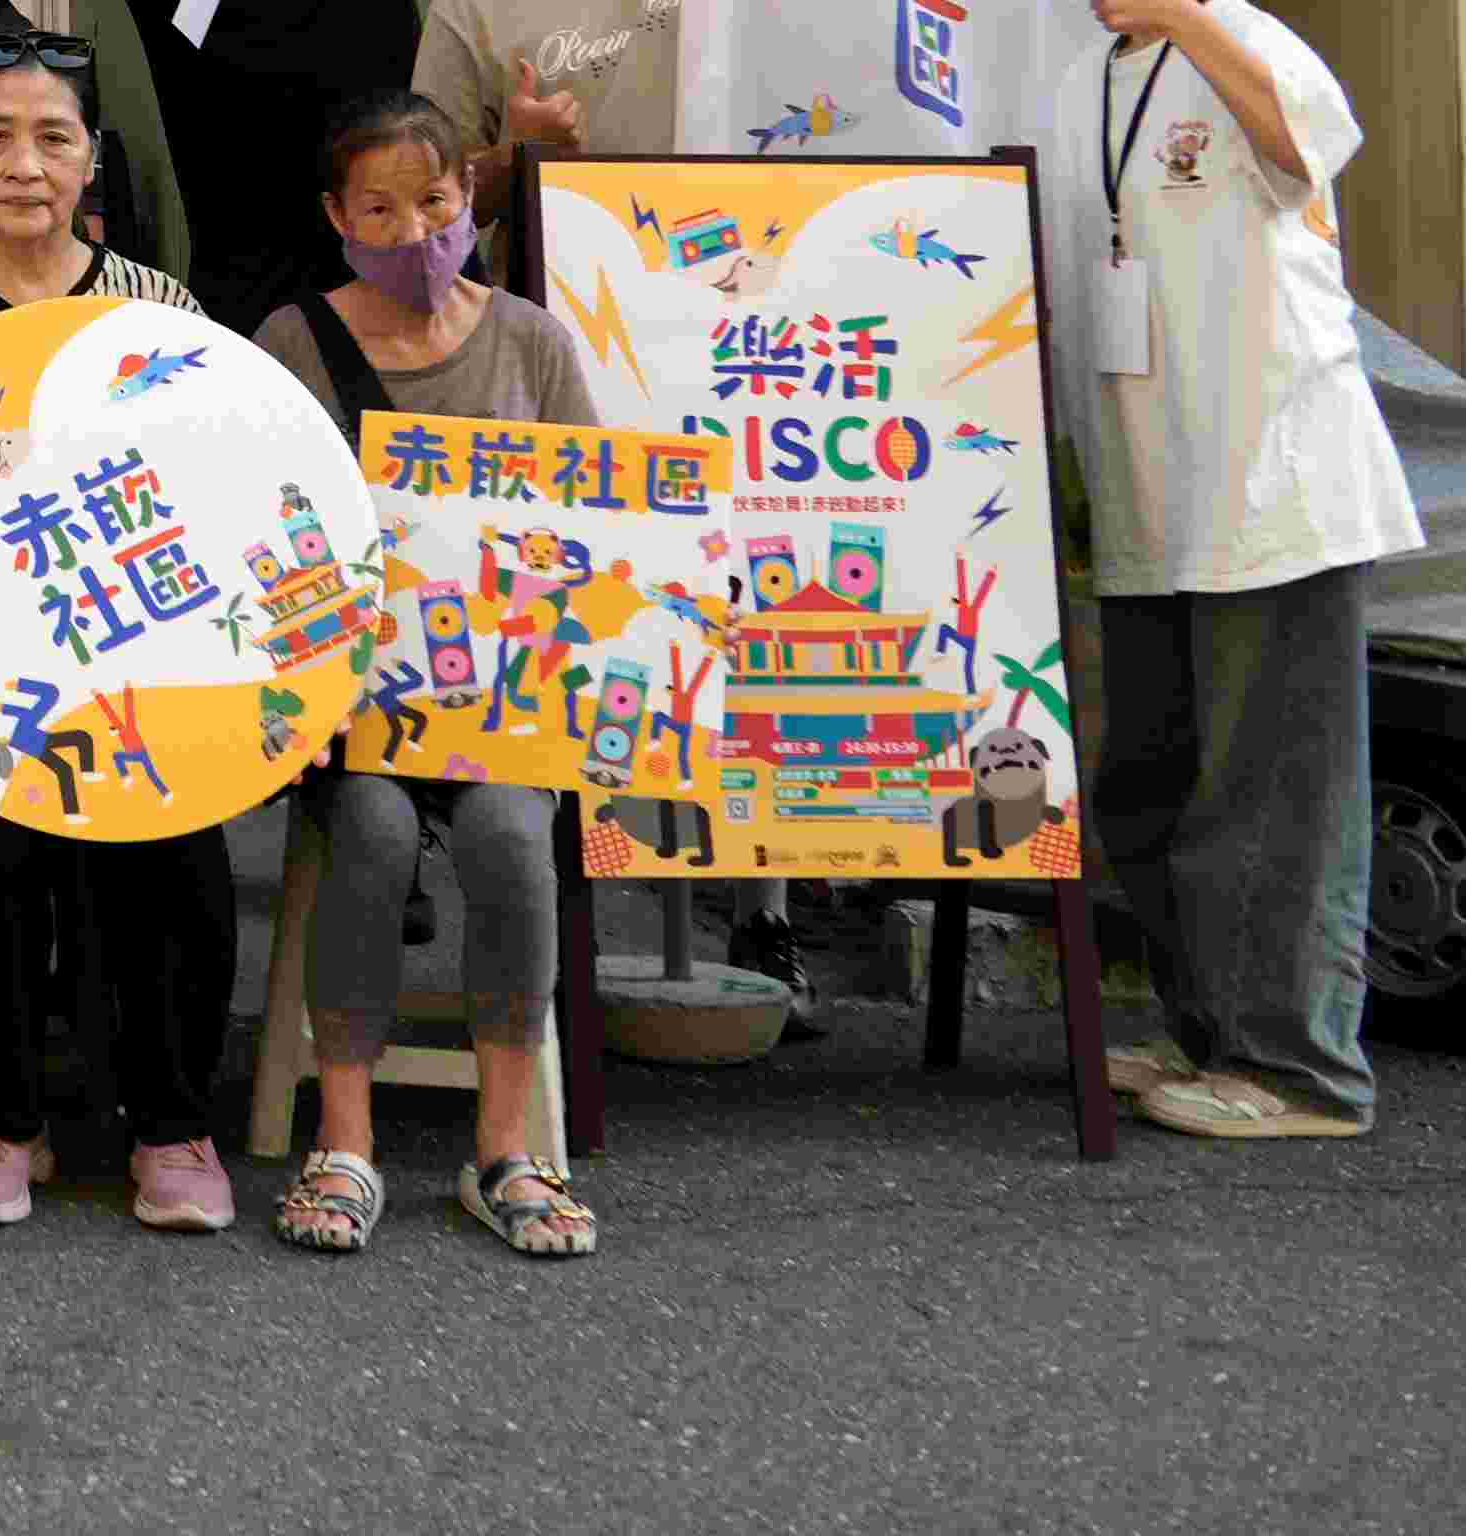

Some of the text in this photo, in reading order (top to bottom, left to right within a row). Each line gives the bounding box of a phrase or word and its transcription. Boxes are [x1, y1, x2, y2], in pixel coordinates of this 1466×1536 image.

[709, 313, 899, 401] 樂活
[381, 424, 711, 516] 赤嵌社區
[682, 414, 933, 482] ISCO
[0, 448, 176, 580] 赤嵌
[39, 524, 221, 666] 社區
